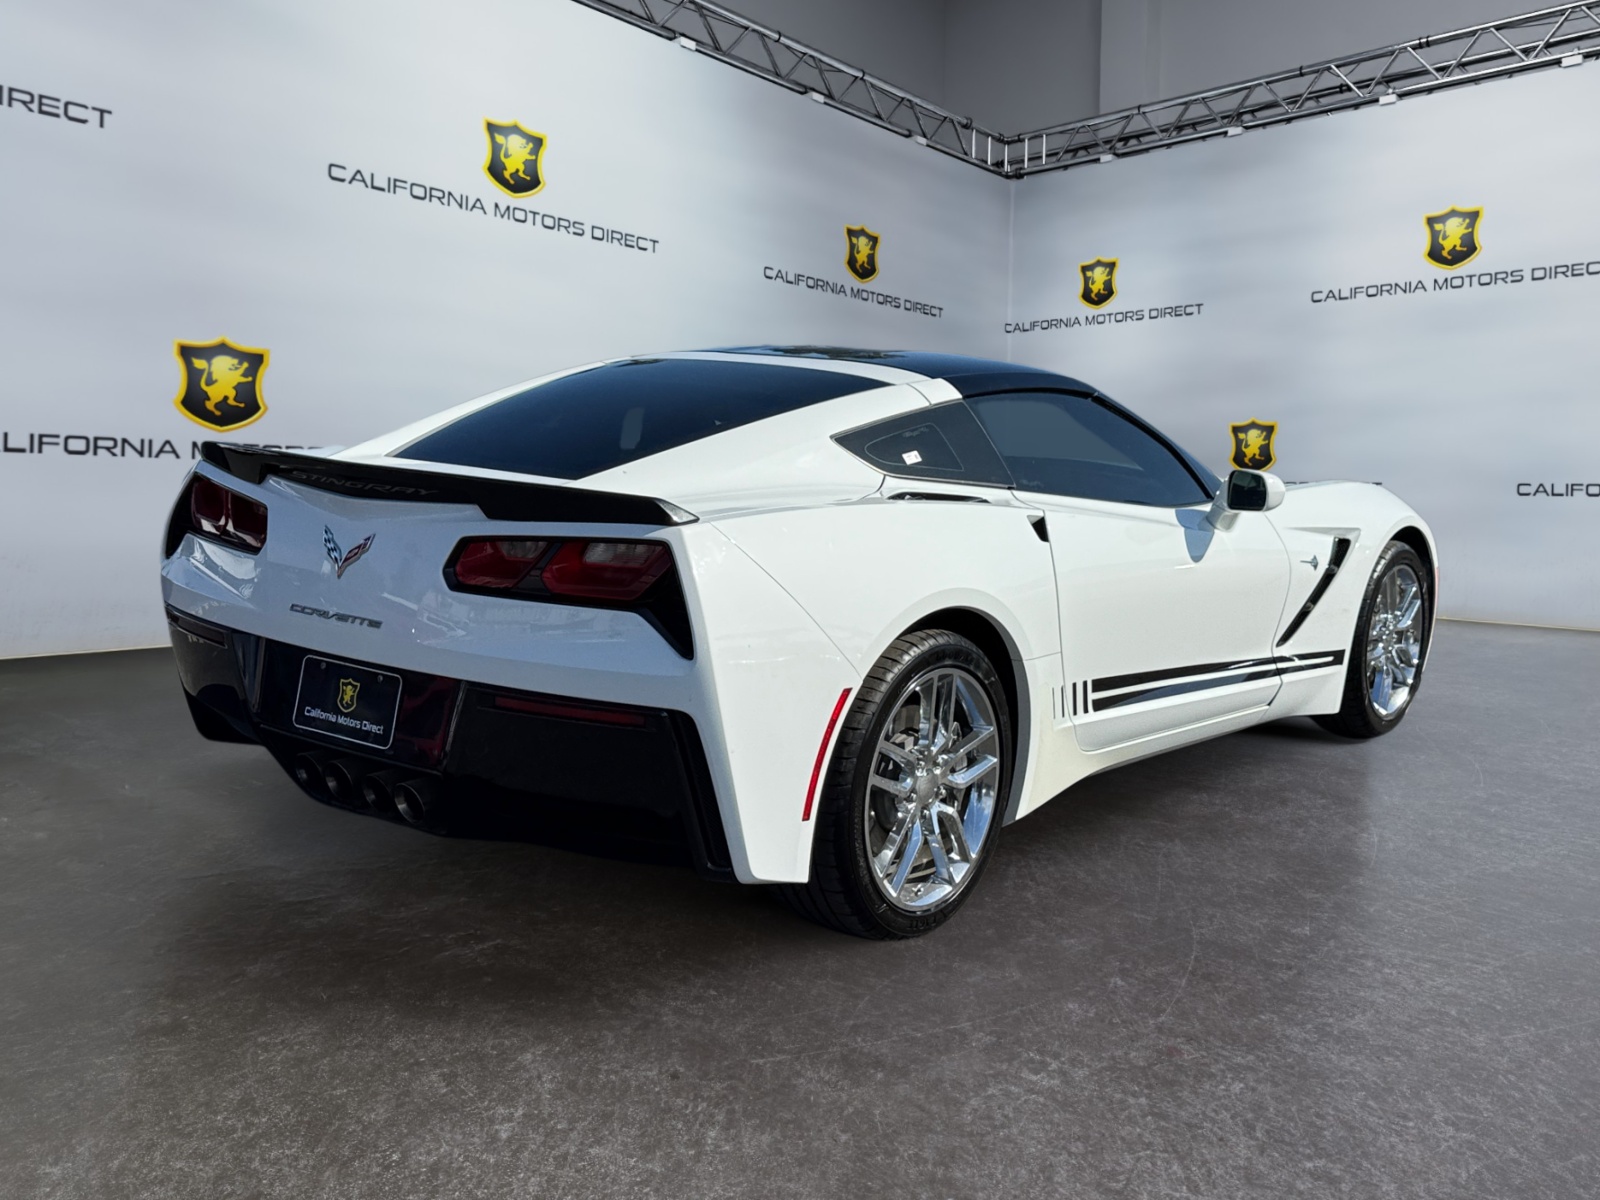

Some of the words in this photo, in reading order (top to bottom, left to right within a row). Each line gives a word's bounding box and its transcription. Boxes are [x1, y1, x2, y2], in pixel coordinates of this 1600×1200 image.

[327, 163, 487, 214] CALIFORNIA
[494, 202, 586, 236] MOTORS
[591, 225, 660, 253] DIRECT
[763, 266, 848, 297] CALIFORNIA
[850, 286, 902, 309] MOTORS
[903, 299, 944, 318] DIRECT
[1310, 280, 1428, 303] CALIFORNIA
[1433, 270, 1525, 291] MOTORS
[1004, 316, 1082, 333] CALIFORNIA
[1085, 309, 1145, 326] MOTORS
[1148, 303, 1204, 320] DIRECT
[0, 431, 180, 460] LIFORNIA
[292, 470, 439, 496] STINGRAY
[1516, 482, 1600, 498] CALIFO
[289, 603, 383, 629] CORVETTE
[304, 706, 337, 723] California
[337, 715, 361, 729] Motors
[361, 720, 384, 735] Direct
